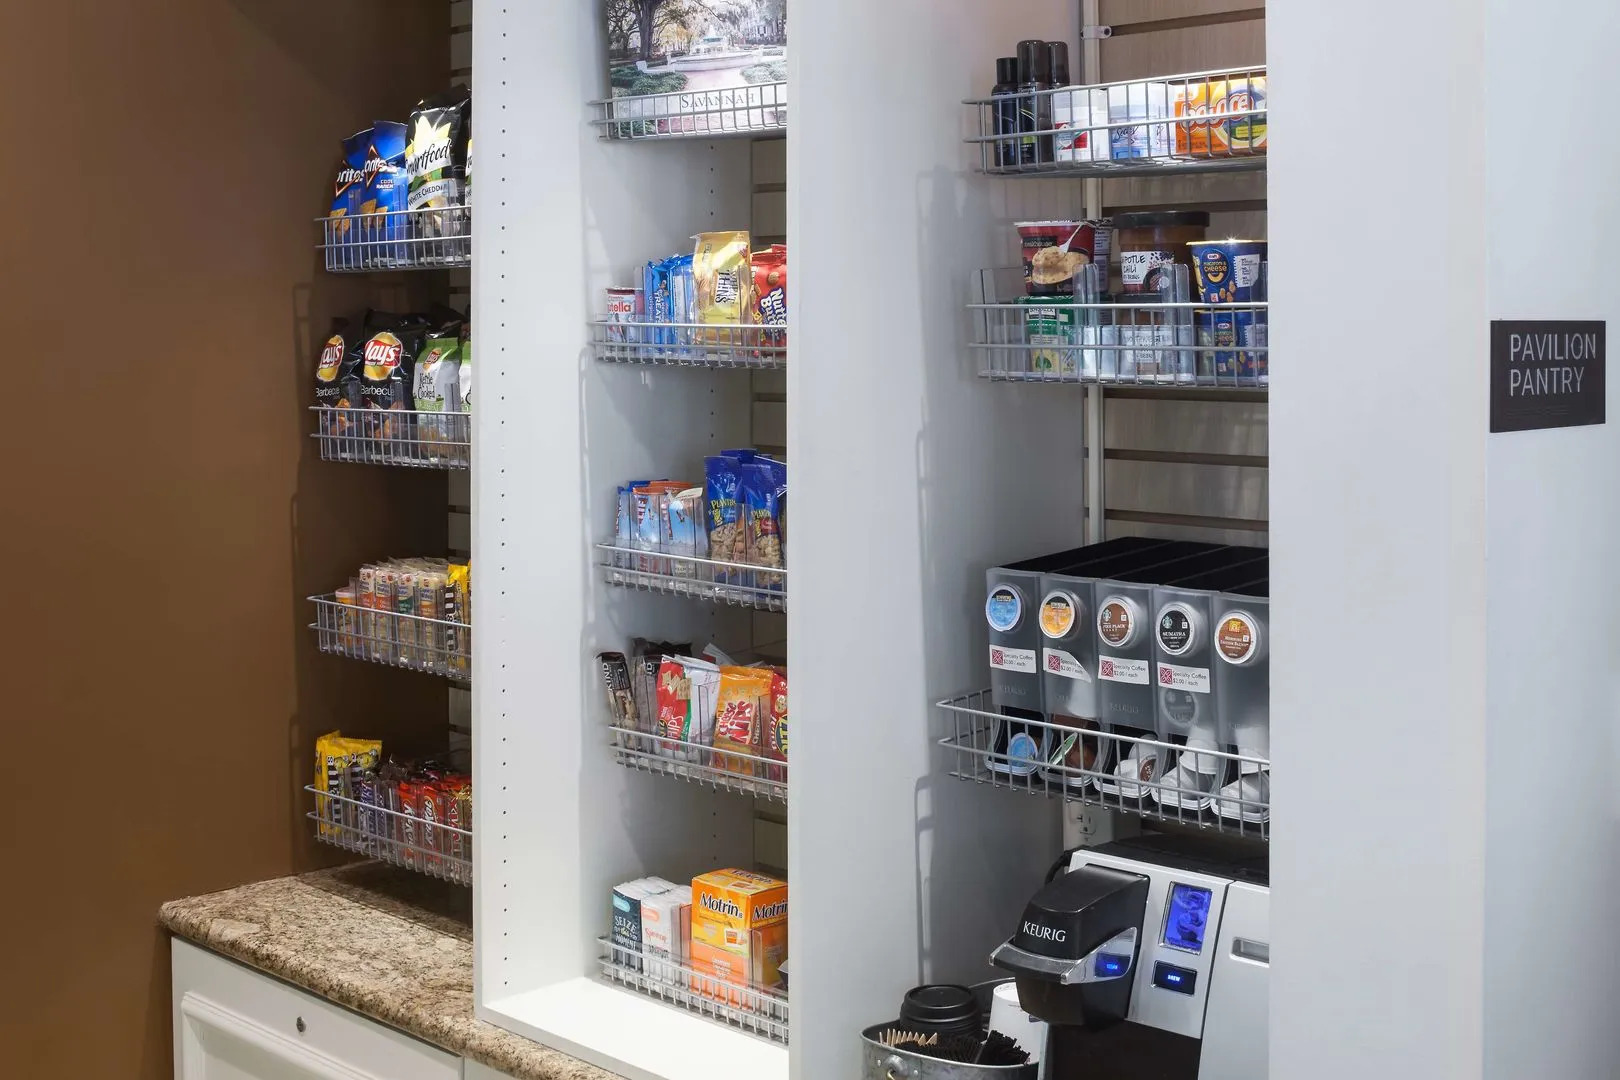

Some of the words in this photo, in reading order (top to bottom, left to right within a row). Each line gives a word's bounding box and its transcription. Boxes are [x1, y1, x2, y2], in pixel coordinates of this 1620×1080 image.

[1510, 333, 1596, 361] PAVILION
[1510, 366, 1584, 396] PANTRY
[1173, 671, 1190, 679] Specialty
[1191, 672, 1207, 680] Coffee
[700, 891, 740, 918] Motrin
[614, 915, 637, 934] SEIZE
[1023, 921, 1066, 943] KEURIG
[1167, 974, 1180, 982] BREW
